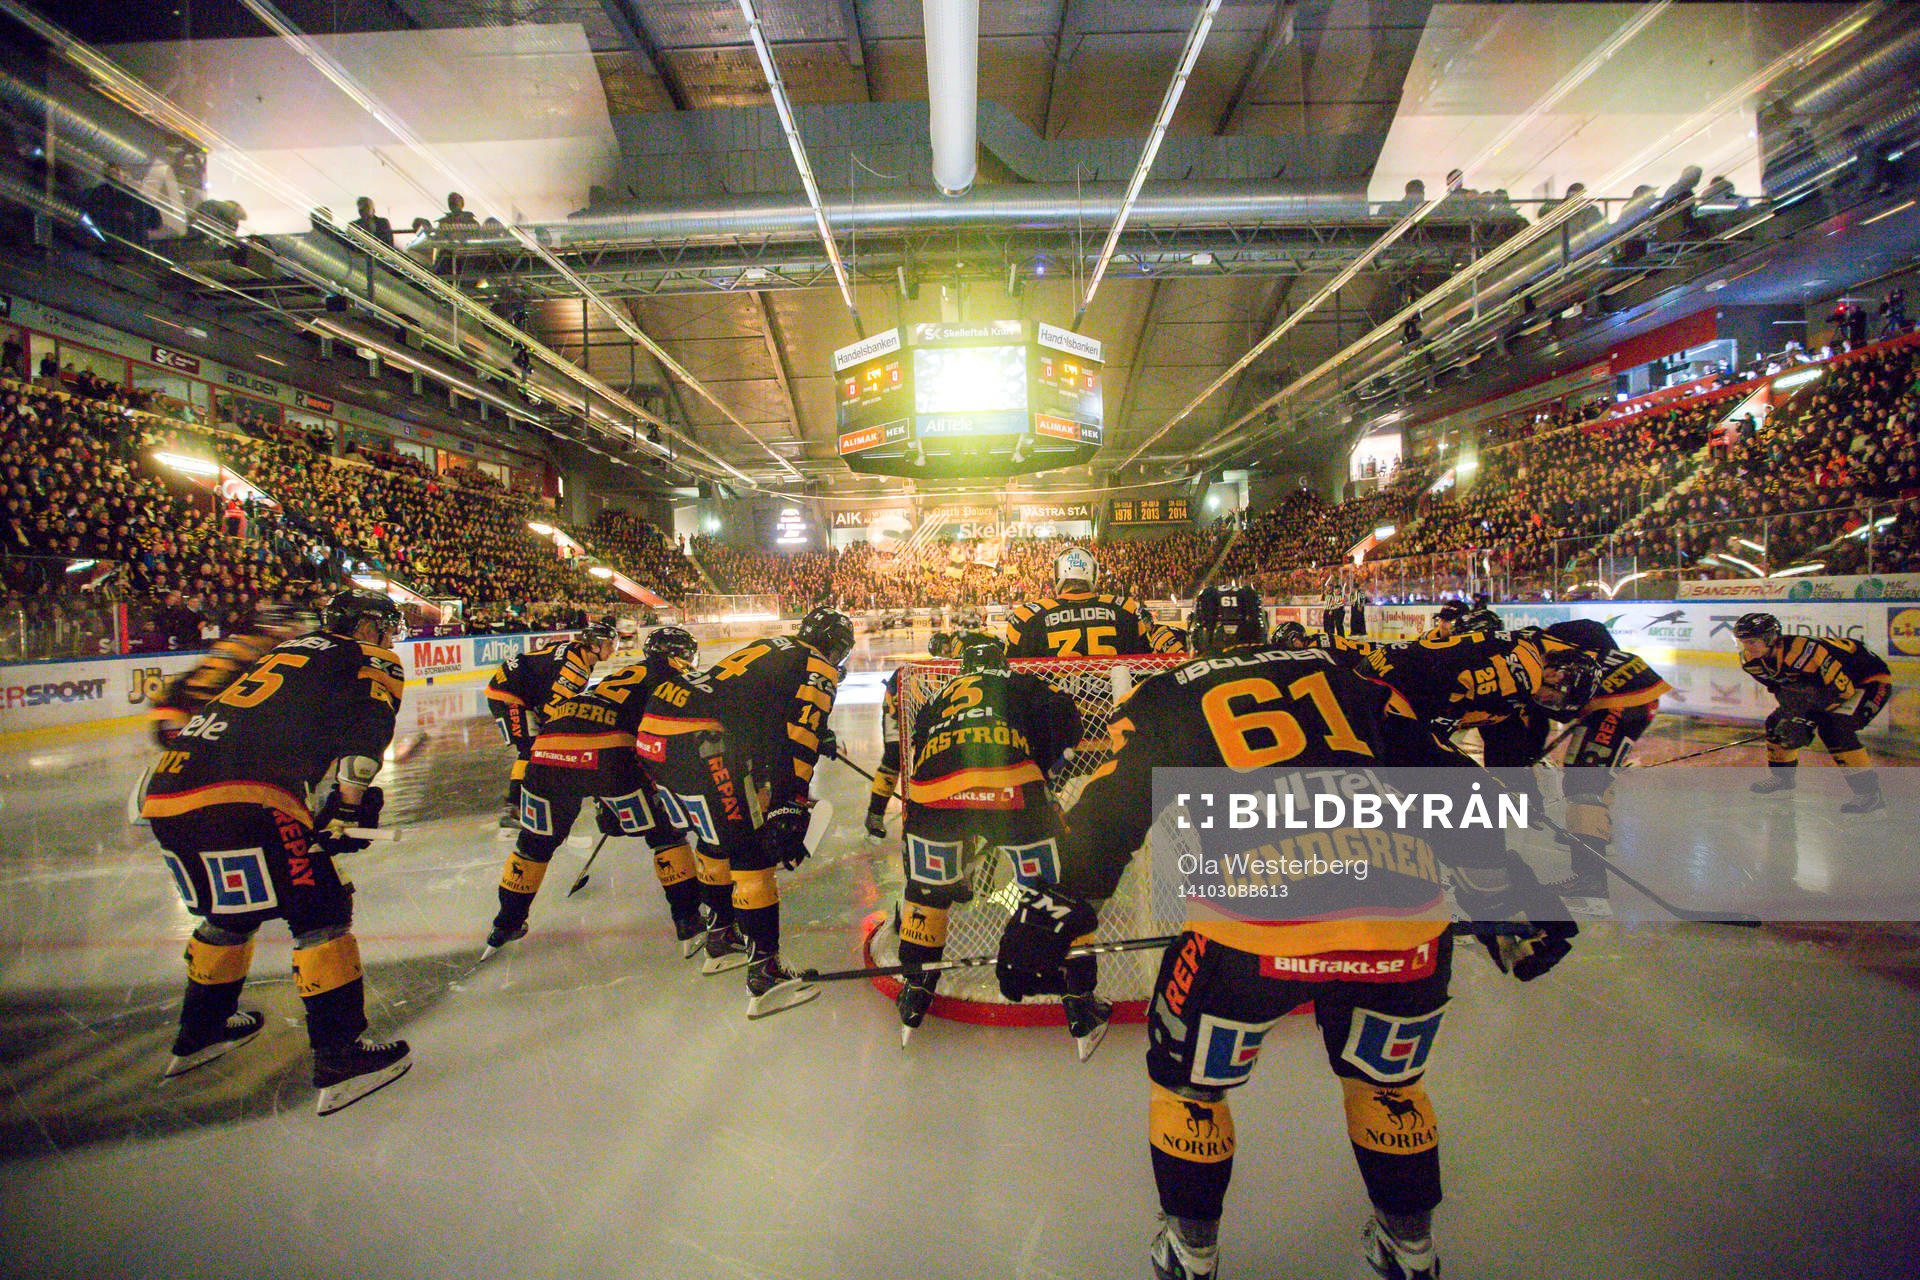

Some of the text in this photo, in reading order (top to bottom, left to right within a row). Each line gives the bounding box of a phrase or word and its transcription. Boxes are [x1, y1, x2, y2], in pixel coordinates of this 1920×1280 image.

[837, 335, 898, 365] Handelsbanken
[1039, 327, 1099, 356] Handelsbanken
[226, 371, 278, 398] BOLIDEN
[842, 425, 905, 448] ALIMAK HEK
[1039, 420, 1099, 440] ALIMAK HEK
[836, 512, 861, 525] AIK
[1067, 505, 1088, 516] STÅ
[1115, 509, 1132, 521] 1978
[1141, 508, 1160, 520] 2013
[1168, 507, 1187, 520] 2014
[1220, 596, 1238, 607] 61
[1691, 581, 1785, 597] SANDSTRÖM
[1050, 607, 1116, 626] BOLIDEN
[1047, 625, 1117, 657] 75
[1649, 627, 1693, 637] ARCTIC CAT
[413, 641, 461, 668] MAXI
[481, 638, 519, 663] AllTele
[716, 644, 772, 681] 4
[1186, 649, 1337, 684] BOLIDEN
[1474, 666, 1498, 695] 25
[941, 675, 984, 719] 3
[556, 701, 618, 727] BERG
[798, 704, 822, 732] 14
[1201, 671, 1376, 774] 61
[708, 756, 744, 821] REPAY
